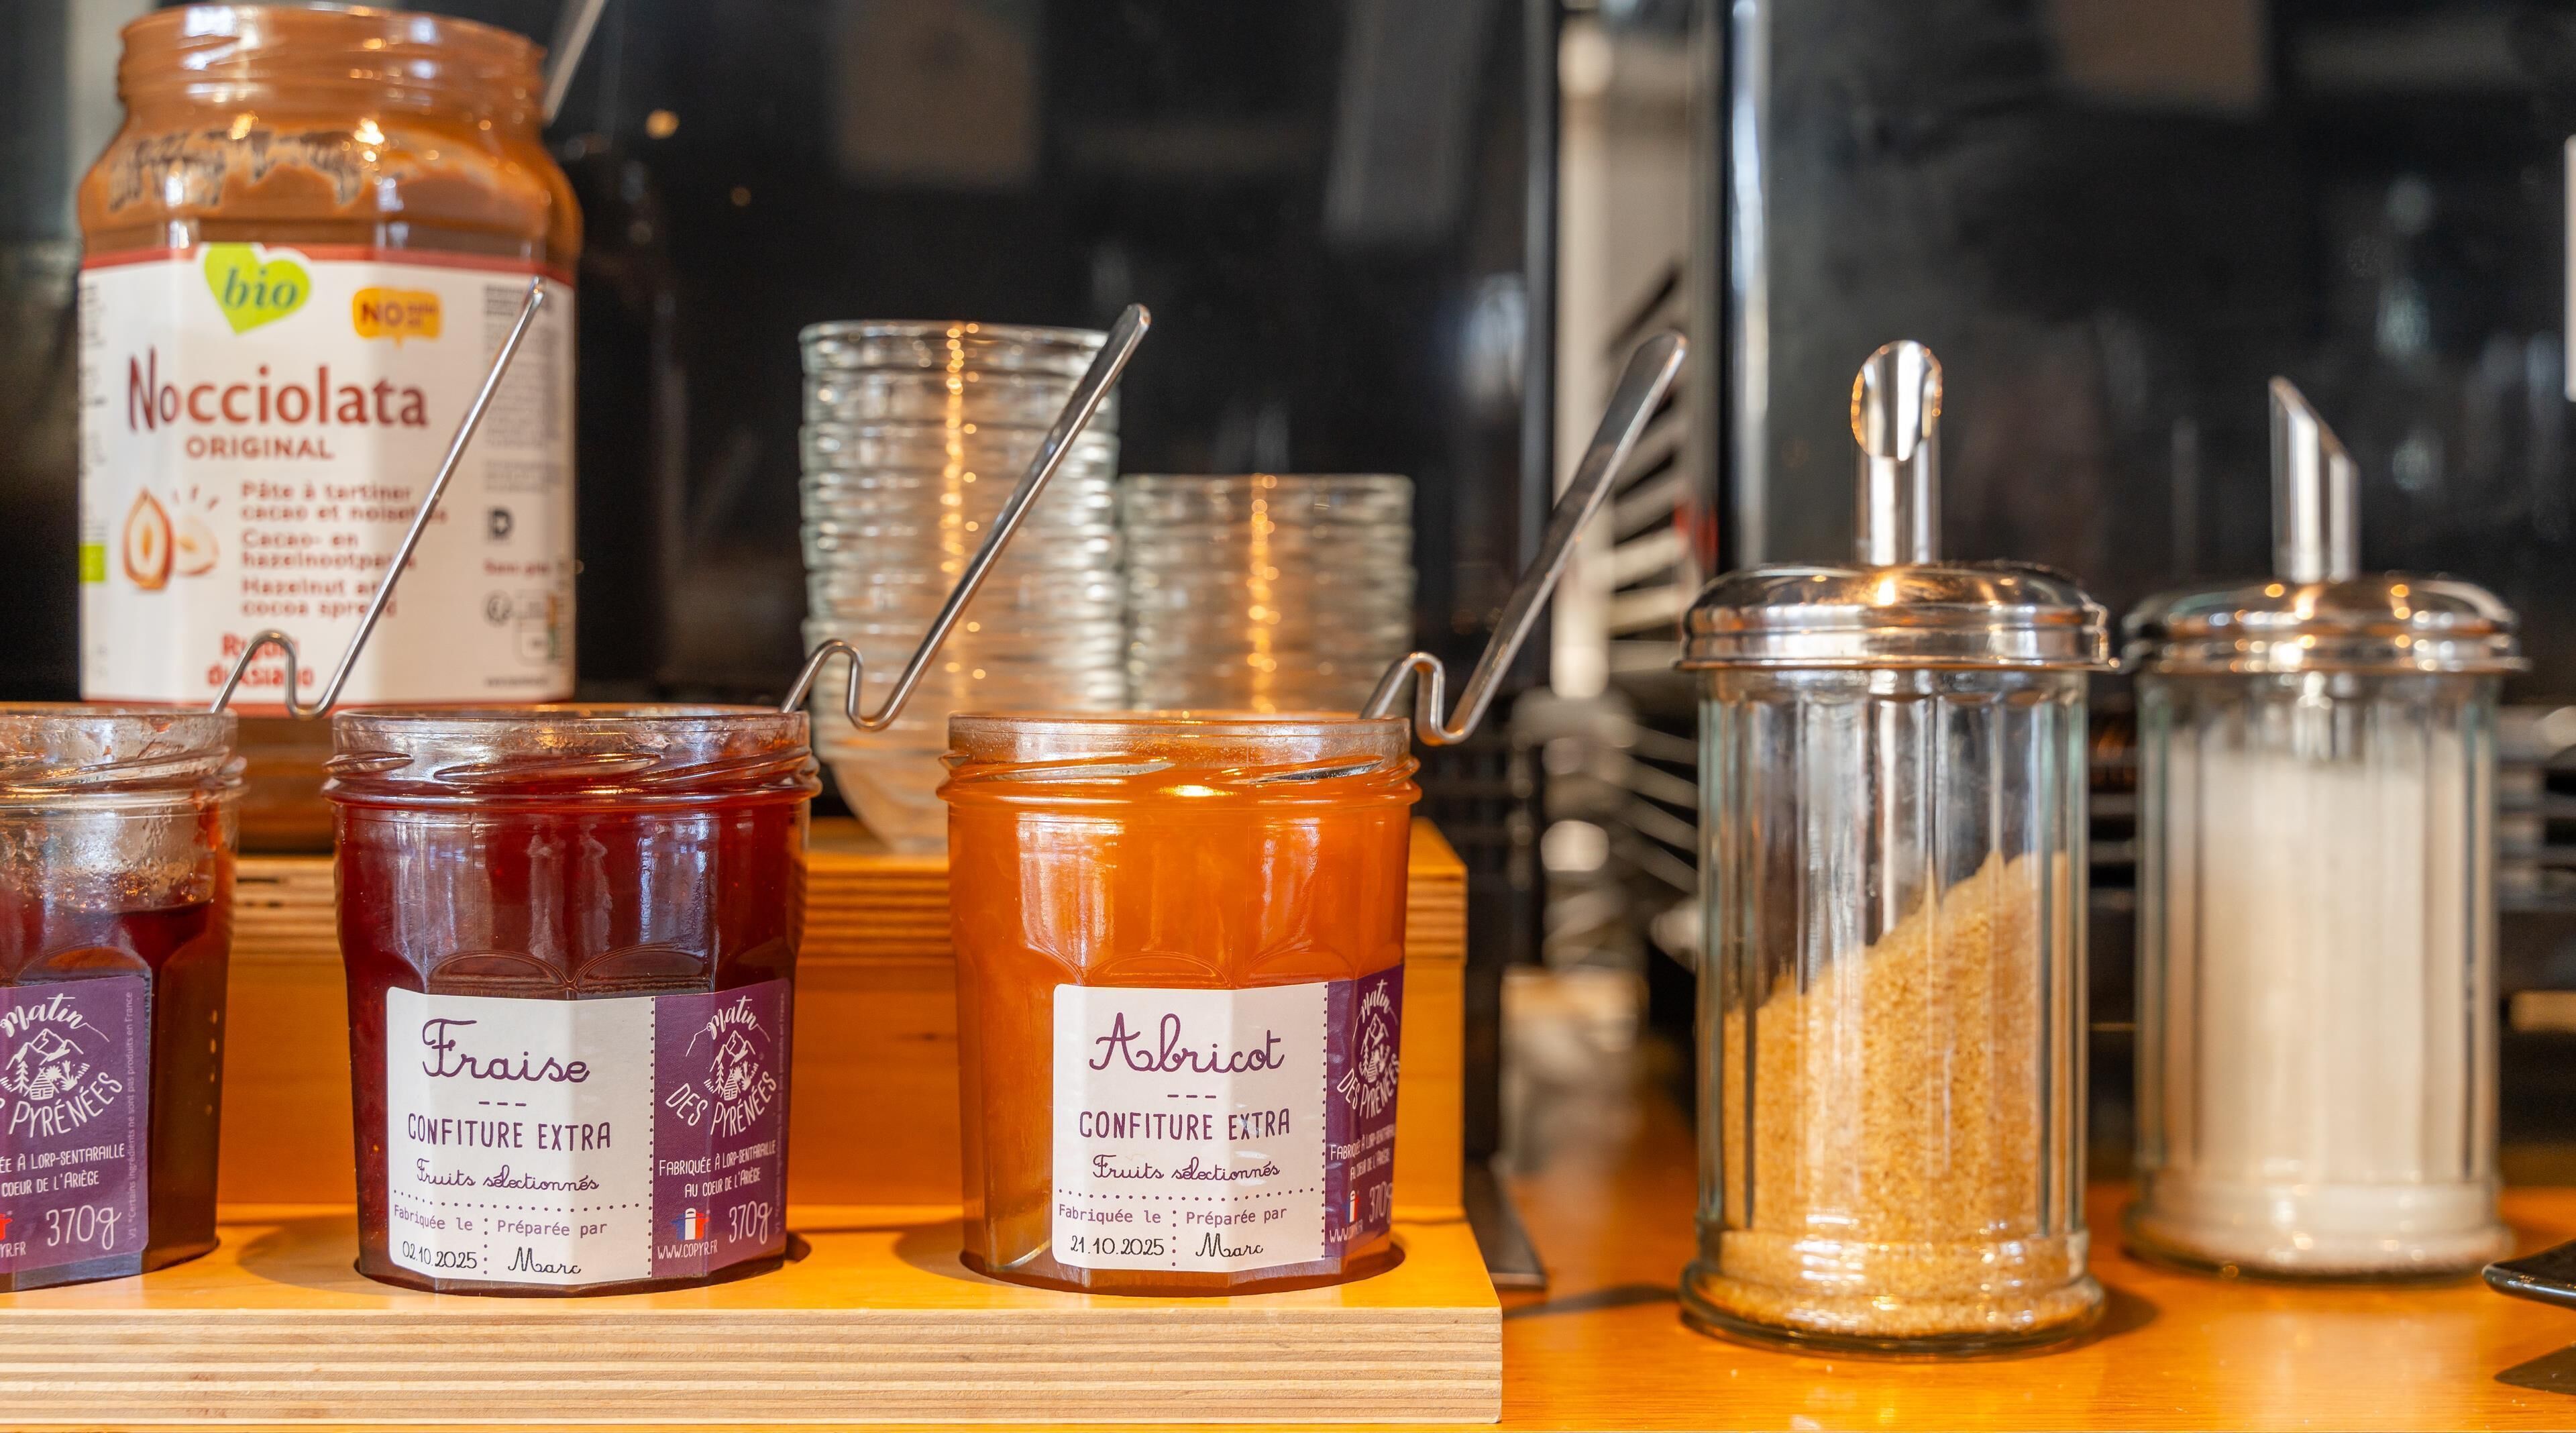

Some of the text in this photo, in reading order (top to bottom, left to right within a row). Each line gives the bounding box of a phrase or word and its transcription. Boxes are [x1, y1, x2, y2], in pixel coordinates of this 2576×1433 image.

[221, 266, 298, 309] bio
[362, 299, 402, 326] NO
[128, 345, 429, 433] Nocciolata
[185, 435, 334, 460] ORIGINAL
[242, 481, 294, 498] Pâte
[325, 484, 411, 500] tartiner
[242, 505, 448, 521] cacao et noisets
[332, 534, 358, 546] en
[242, 552, 417, 570] hazelnootpaa
[242, 578, 345, 594] Hazelnut
[243, 599, 397, 618] cocoa spred
[0, 993, 83, 1037] Matin
[125, 992, 133, 1022] France
[706, 995, 757, 1040] Matin
[126, 1023, 133, 1036] en
[1089, 1012, 1285, 1073] Abricot
[126, 1037, 135, 1075] produits
[422, 1018, 590, 1083] Fraise
[127, 1076, 136, 1092] pas
[1337, 1053, 1400, 1119] DES PYRÉNÉES
[8, 1071, 123, 1138] PYRÉNÉES
[665, 1071, 777, 1138] DES PYRÉNÉES
[128, 1116, 134, 1128] ne
[408, 1113, 610, 1151] CONFITURE EXTRA
[1079, 1108, 1290, 1140] CONFITURE EXTRA
[17, 1153, 26, 1171] À
[31, 1143, 125, 1169] LORP-SENTARAILLE
[659, 1157, 711, 1176] FABRIQUÉE
[714, 1153, 720, 1171] À
[1093, 1155, 1280, 1181] Fruits sélectionnés
[1, 1179, 32, 1197] COEUR
[36, 1177, 49, 1193] DE
[417, 1158, 600, 1191] Fruits sélectionnés
[685, 1183, 698, 1198] AU
[702, 1178, 723, 1197] COEUR
[724, 1176, 732, 1192] DE
[394, 1204, 473, 1230] Fabriquée le
[729, 1201, 773, 1245] 370g
[1059, 1204, 1161, 1224] Fabriquée le
[1186, 1207, 1287, 1228] Préparée par
[46, 1205, 122, 1251] 370g
[498, 1220, 608, 1238] Préparée par
[402, 1240, 478, 1269] 02.10.2025
[657, 1240, 718, 1259] WWW.COPYR.FR
[1070, 1235, 1165, 1255] 21.10.2025
[1195, 1232, 1264, 1257] Marc
[508, 1246, 582, 1274] Marc
